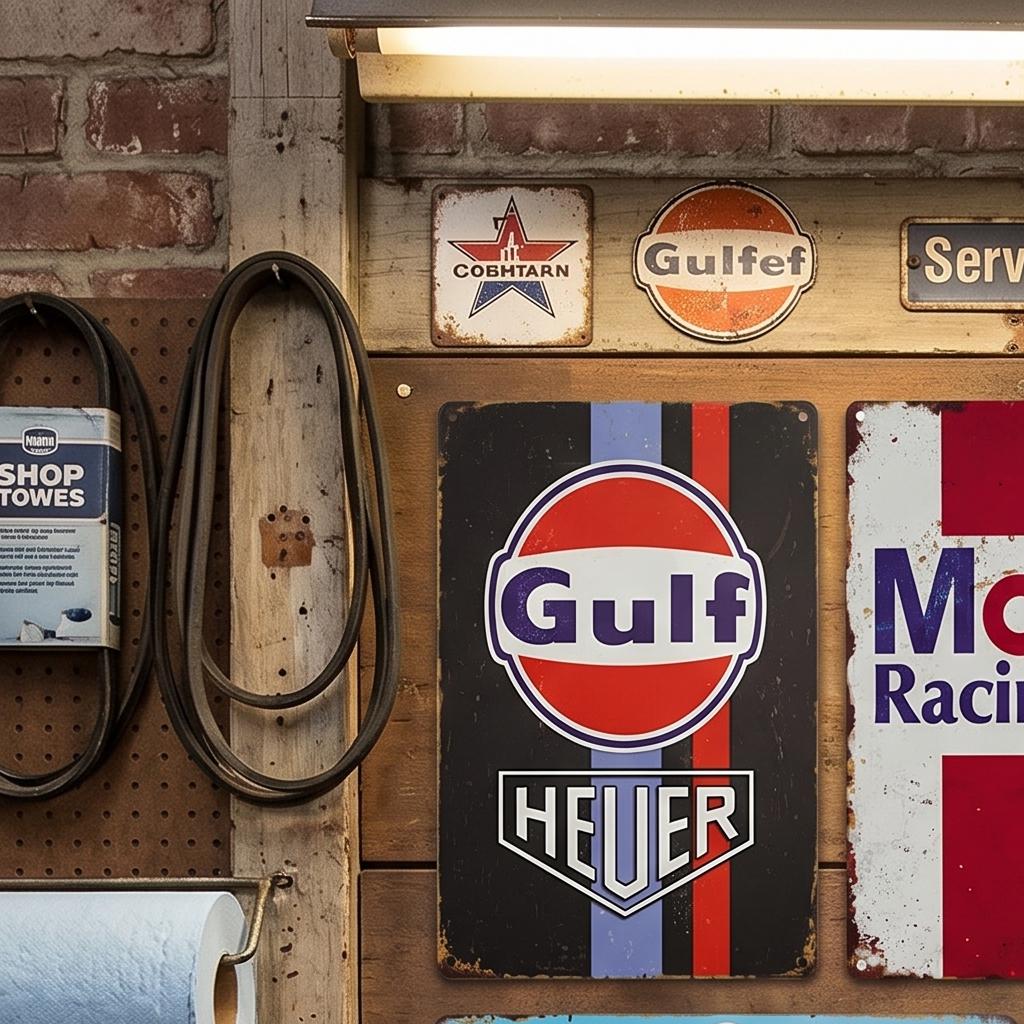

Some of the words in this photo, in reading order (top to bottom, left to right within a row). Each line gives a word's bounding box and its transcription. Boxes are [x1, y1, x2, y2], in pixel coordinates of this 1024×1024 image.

[644, 242, 806, 276] Gulfef
[0, 463, 85, 487] SHOP
[0, 488, 86, 508] TOWES
[500, 566, 751, 647] Gulf
[515, 786, 738, 900] HEUER
